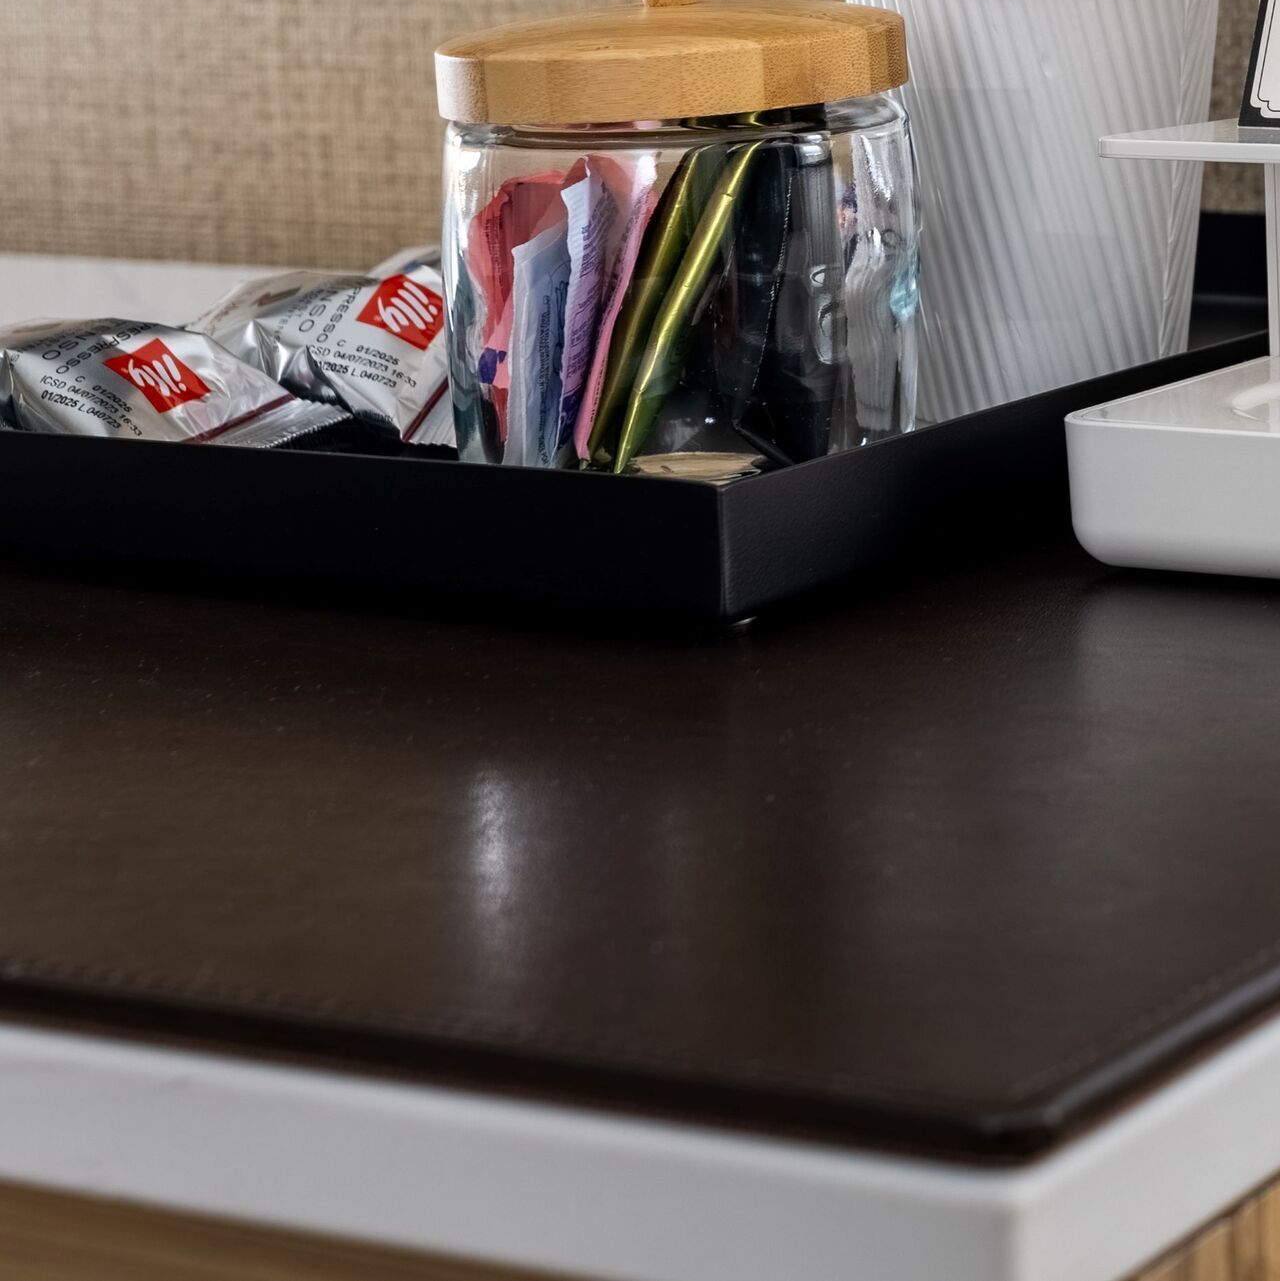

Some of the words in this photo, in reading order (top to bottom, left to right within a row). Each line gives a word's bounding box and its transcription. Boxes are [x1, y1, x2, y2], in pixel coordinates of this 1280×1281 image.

[377, 281, 438, 333] illy
[309, 344, 331, 357] CSD
[128, 353, 187, 397] illy
[40, 389, 80, 408] 01/2025
